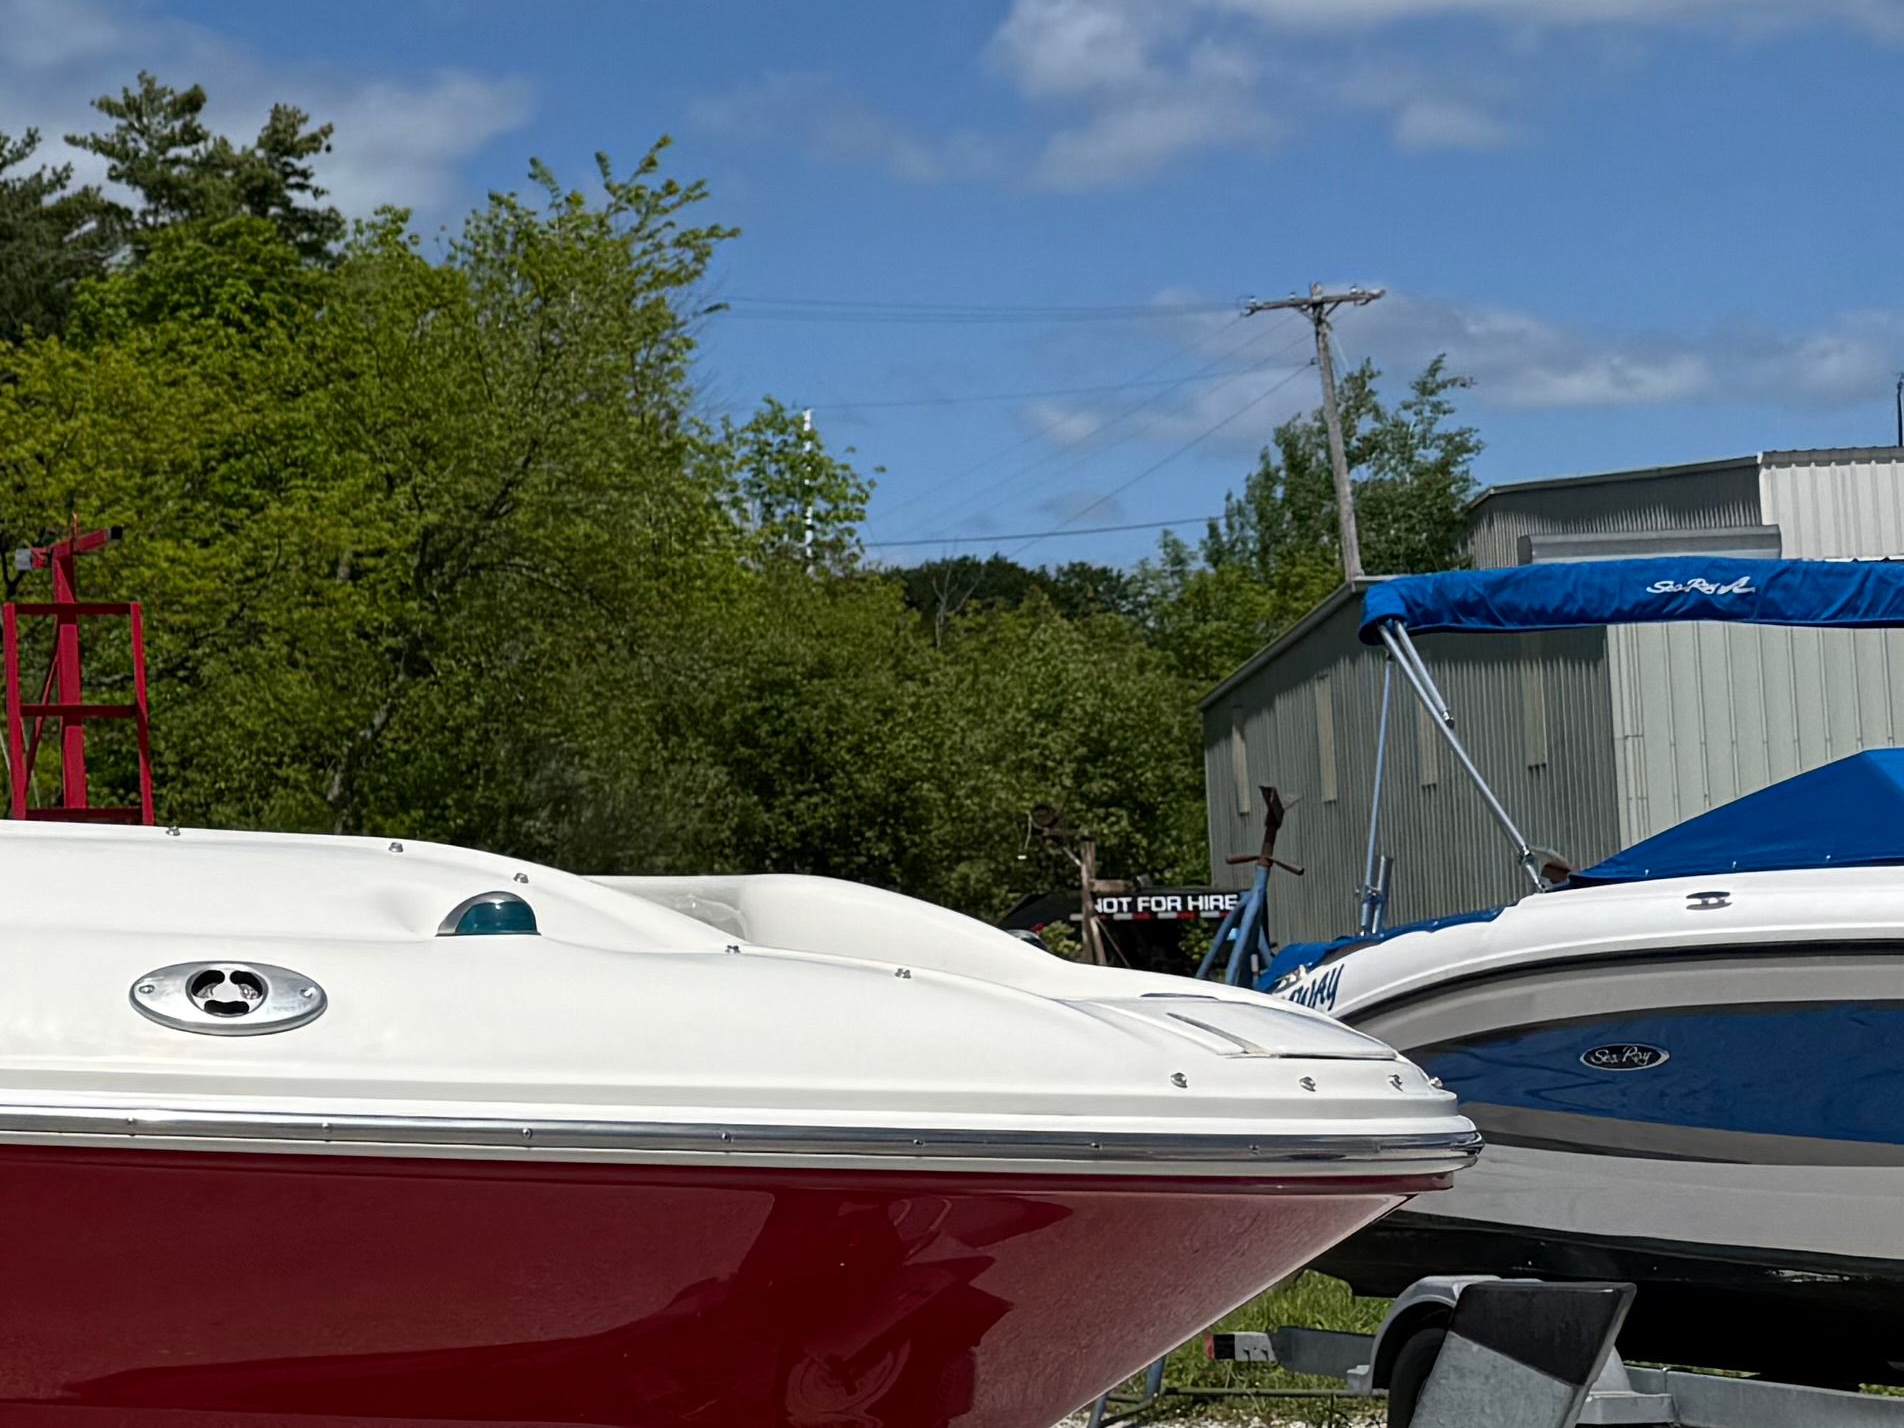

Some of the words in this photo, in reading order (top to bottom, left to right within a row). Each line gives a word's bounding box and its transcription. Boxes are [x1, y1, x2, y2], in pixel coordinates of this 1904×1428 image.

[1137, 896, 1182, 912] FOR
[1187, 894, 1238, 911] HIRE
[1589, 1049, 1619, 1065] Sea
[1622, 1045, 1652, 1066] Ray
